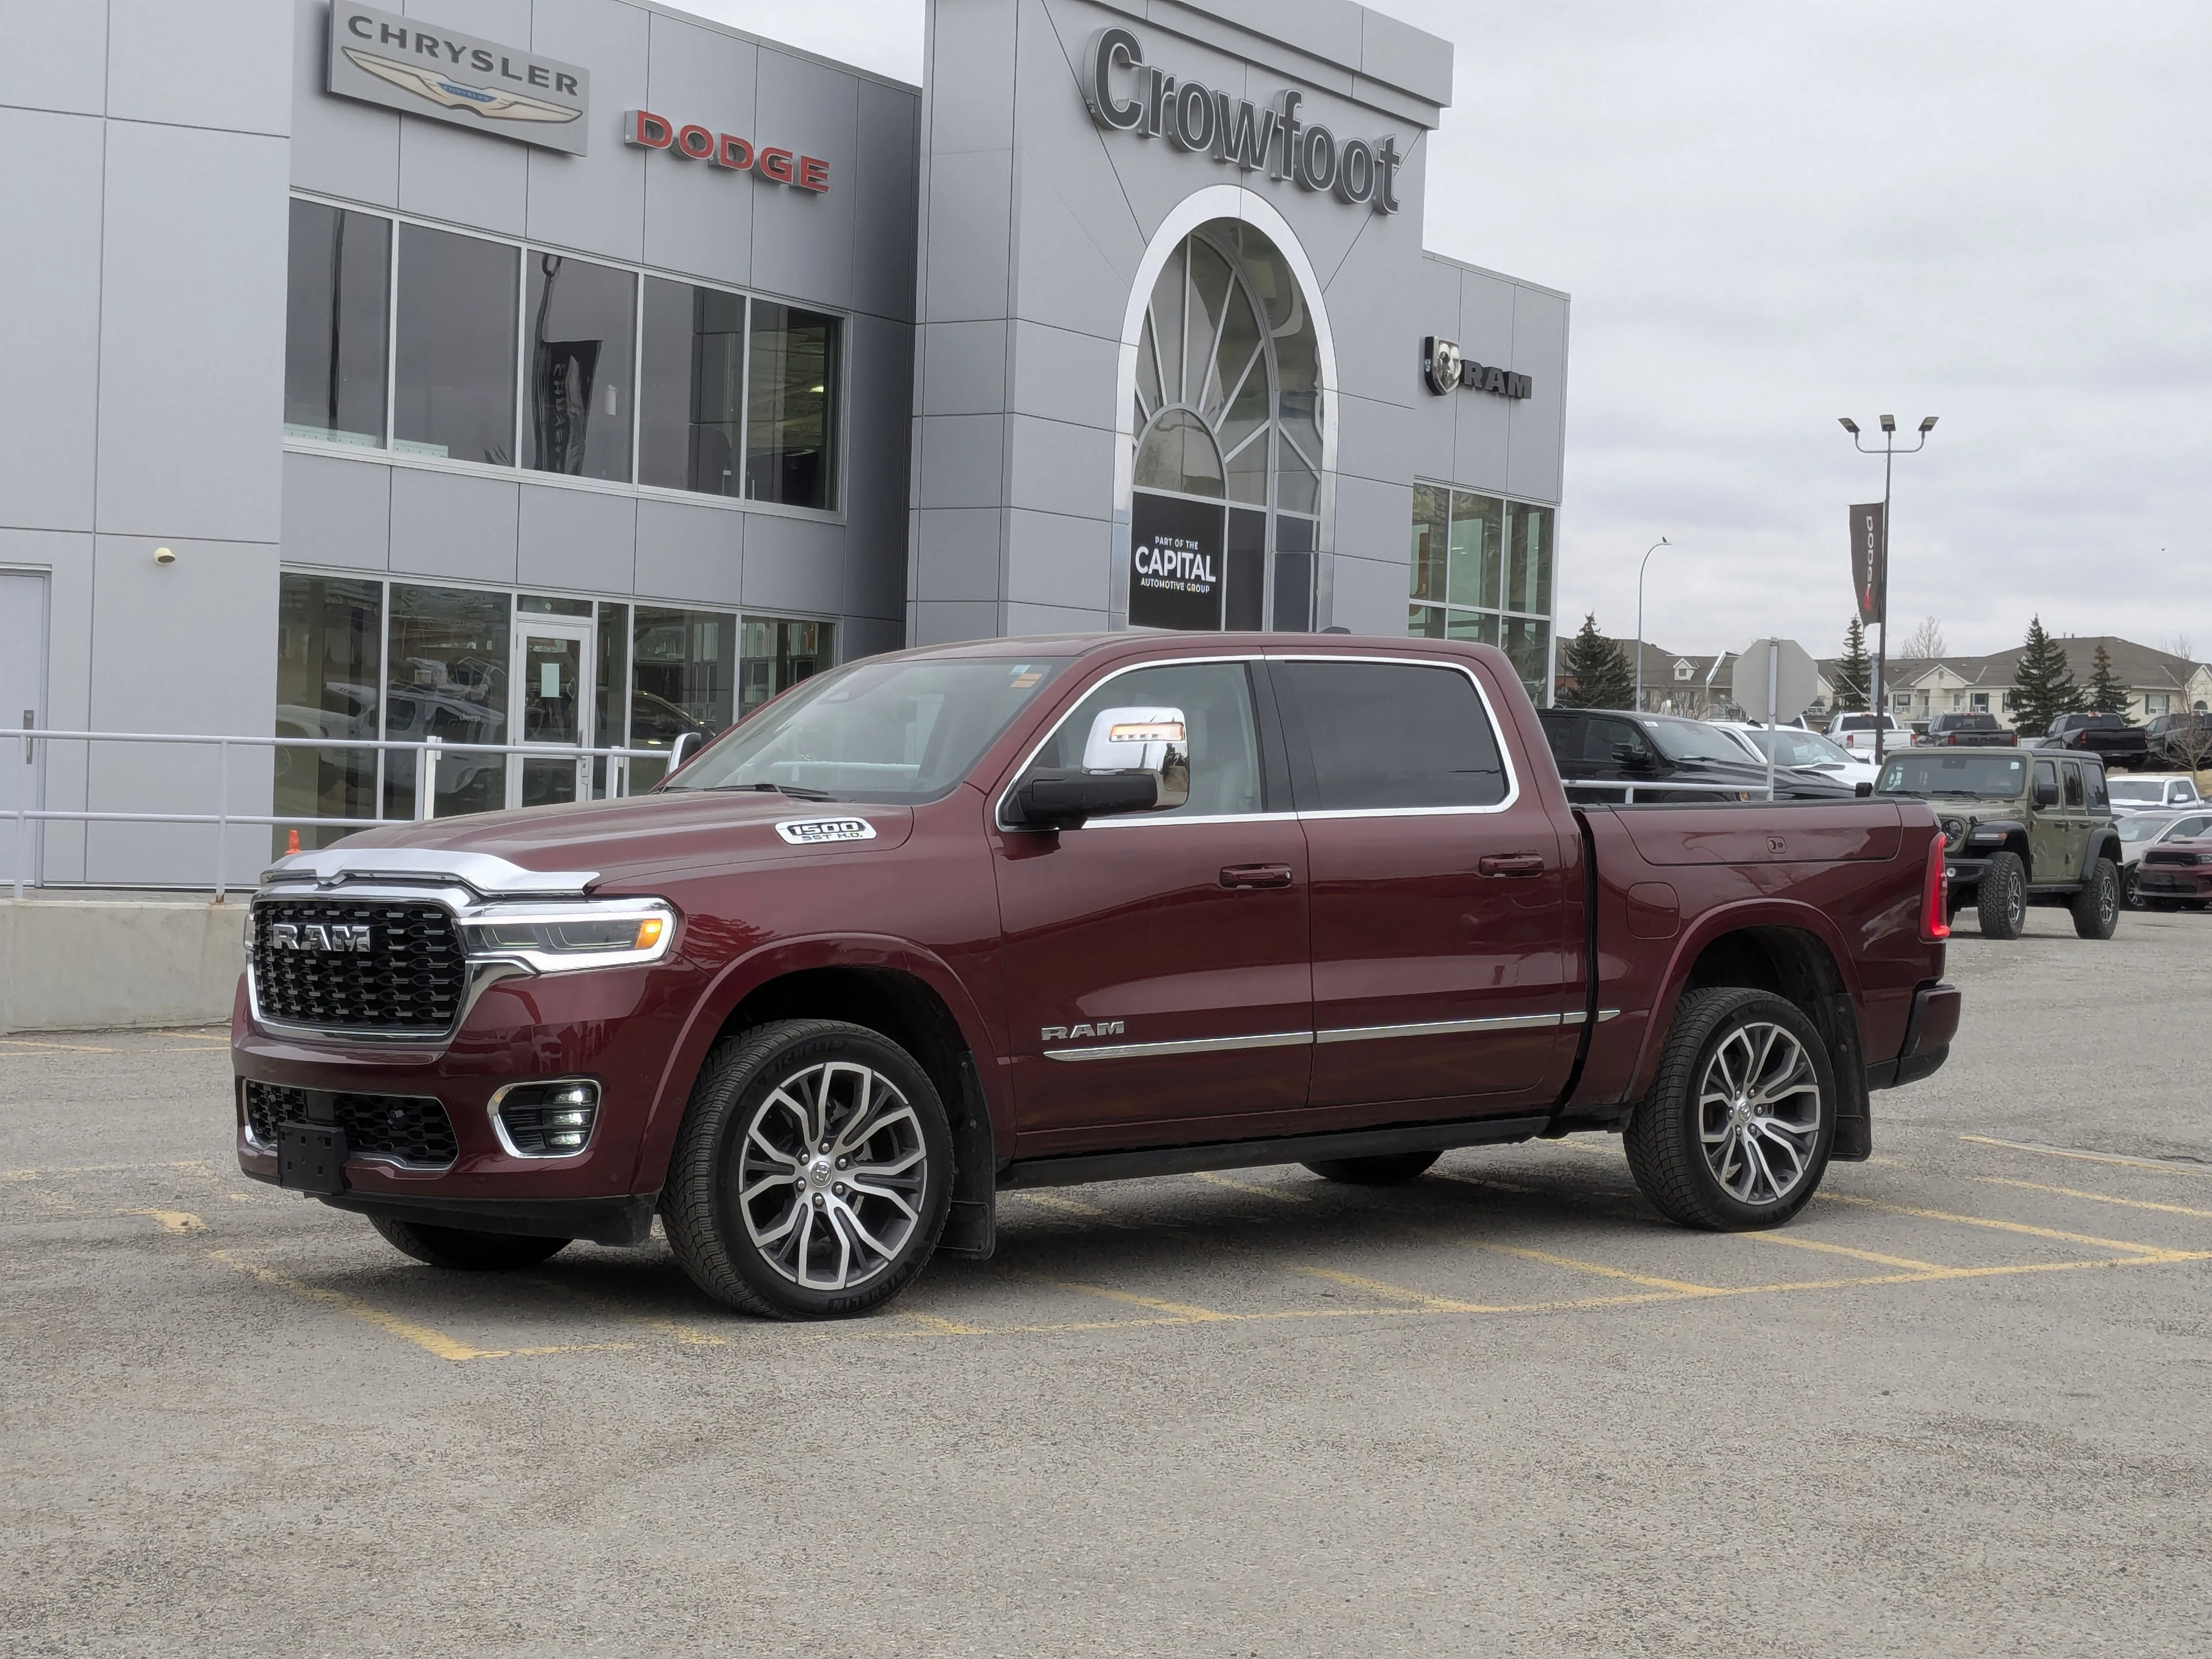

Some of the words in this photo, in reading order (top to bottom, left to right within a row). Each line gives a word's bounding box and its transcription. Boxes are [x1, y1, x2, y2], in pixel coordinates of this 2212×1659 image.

[348, 15, 578, 96] CHRYSLER
[1091, 26, 1401, 215] Crowfoot
[635, 110, 830, 194] DODGE
[1462, 359, 1532, 399] RAM
[1155, 535, 1173, 547] PART
[1175, 539, 1184, 548] OF
[1186, 540, 1199, 550] THE
[1135, 546, 1216, 583] CAPITAL
[1140, 578, 1184, 591] AUTOMOTIVE
[1187, 583, 1210, 594] GROUP
[791, 821, 859, 835] 1500
[273, 924, 370, 952] RAM
[1041, 1021, 1125, 1041] RAM
